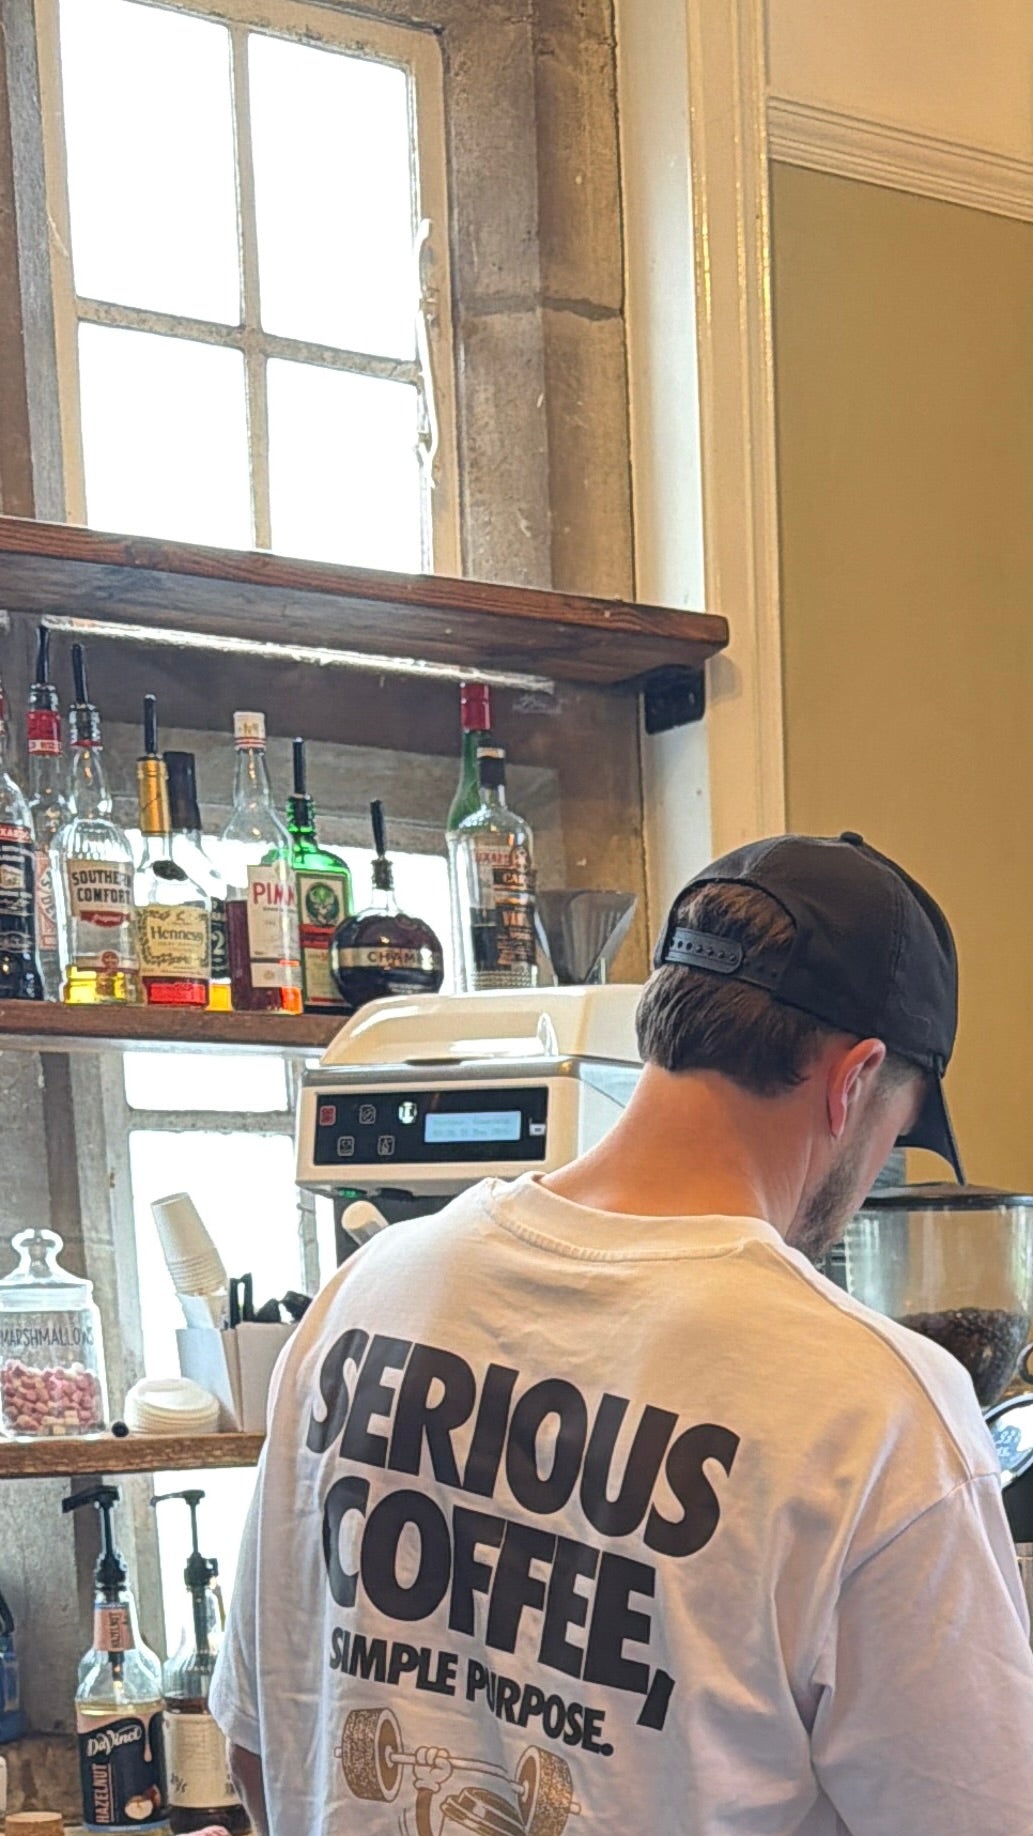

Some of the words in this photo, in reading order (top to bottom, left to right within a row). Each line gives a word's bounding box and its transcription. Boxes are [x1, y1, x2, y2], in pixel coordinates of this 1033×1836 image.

[77, 887, 131, 904] COMFORT
[1, 1326, 95, 1348] MARSHMALLOWS
[306, 1328, 740, 1558] SERIOUS
[322, 1476, 676, 1730] COFFEE,
[329, 1627, 458, 1696] SIMPLE
[92, 1764, 110, 1823] HAZELNUT
